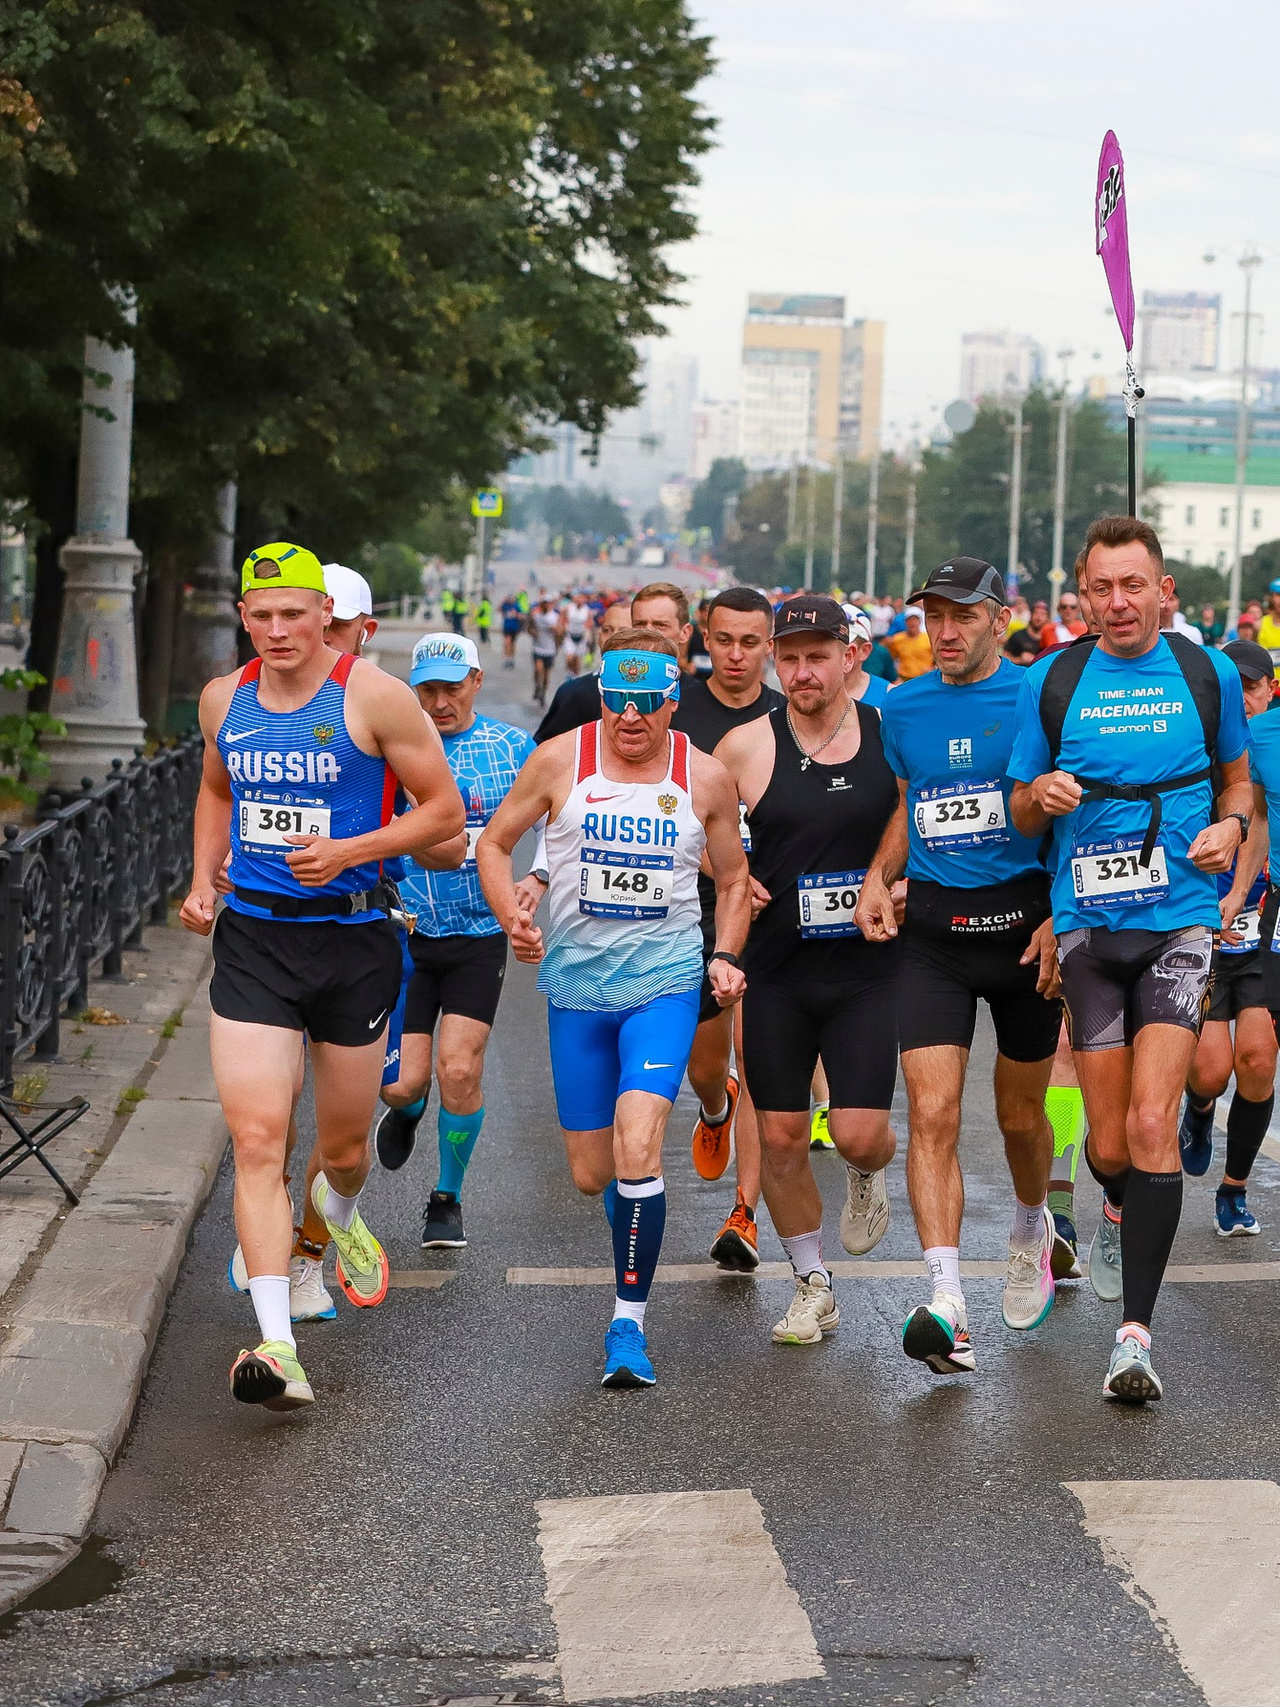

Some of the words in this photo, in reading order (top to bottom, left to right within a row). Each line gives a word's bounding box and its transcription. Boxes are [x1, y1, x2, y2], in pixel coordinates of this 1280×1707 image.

[1080, 702, 1183, 720] PACEMAKER
[1099, 724, 1150, 734] salomon
[226, 751, 342, 783] RUSSIA
[258, 808, 302, 832] 381
[935, 798, 981, 823] 323
[581, 813, 679, 847] RUSSIA
[1096, 856, 1139, 880] 321
[602, 870, 648, 893] 148
[610, 893, 636, 902] Юрий
[824, 890, 858, 912] 30
[952, 910, 1023, 926] REXCHI
[628, 1203, 641, 1269] COMPRESSPORT
